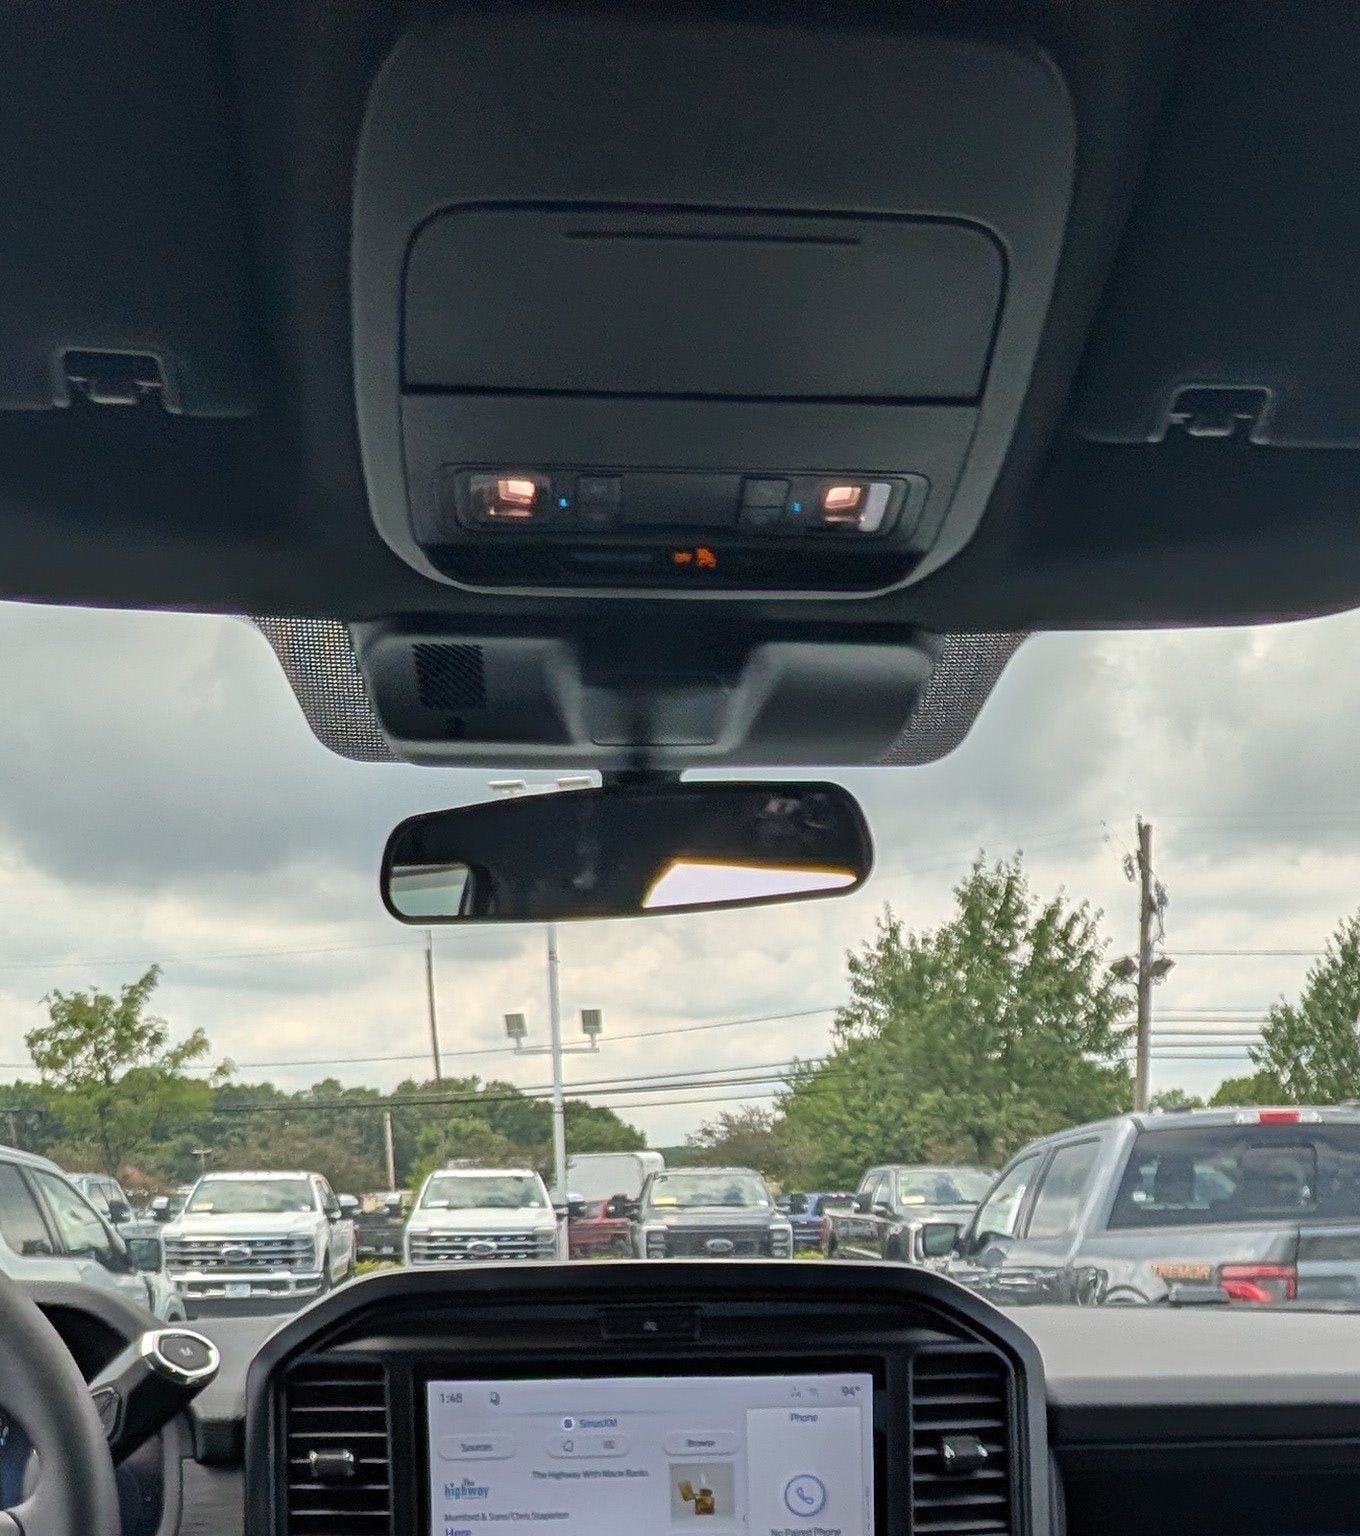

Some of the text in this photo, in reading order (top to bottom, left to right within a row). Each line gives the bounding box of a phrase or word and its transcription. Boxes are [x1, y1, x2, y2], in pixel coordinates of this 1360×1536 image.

[439, 1393, 463, 1404] 1:48
[790, 1413, 818, 1423] Phone
[444, 1483, 490, 1499] highway
